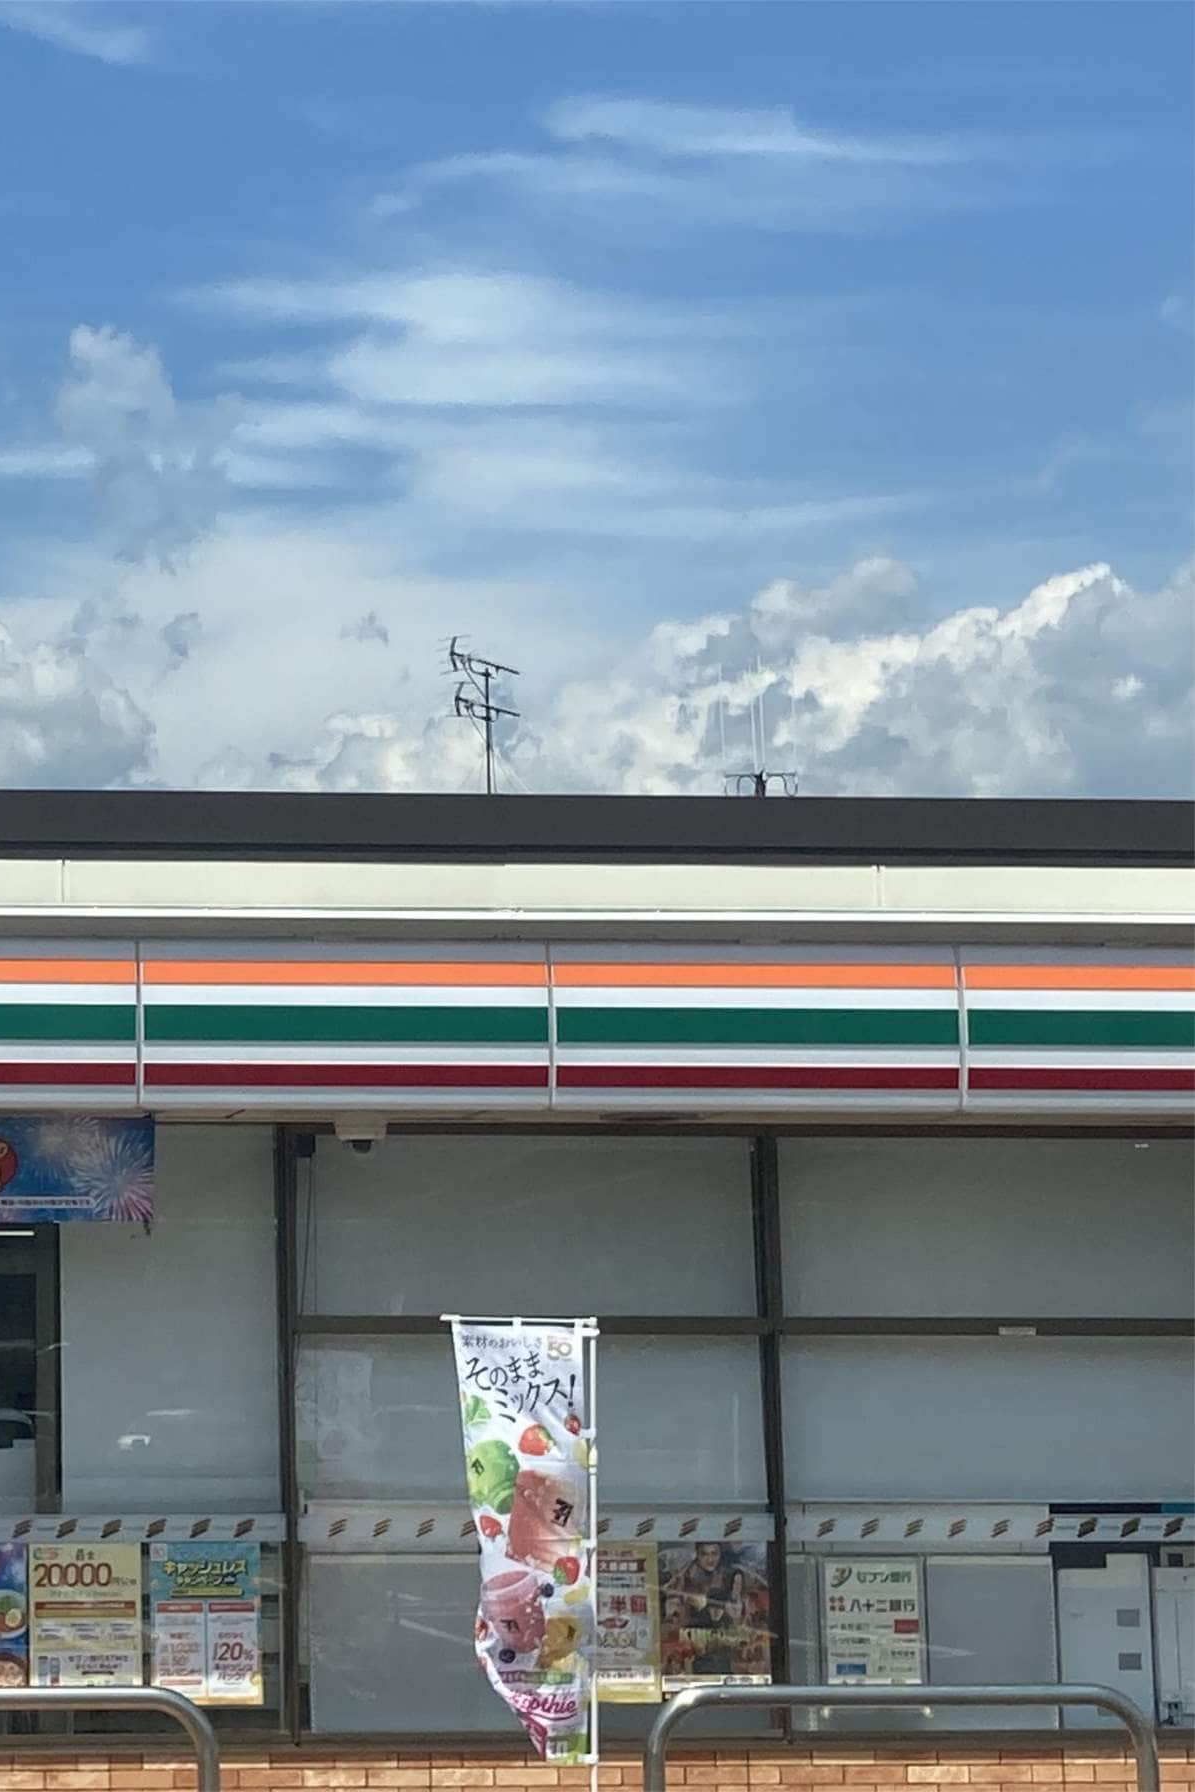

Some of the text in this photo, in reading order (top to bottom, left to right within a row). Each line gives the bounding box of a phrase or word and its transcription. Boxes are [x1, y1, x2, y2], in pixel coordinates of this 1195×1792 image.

[465, 1351, 545, 1392] そのまま
[34, 1562, 113, 1588] 20000
